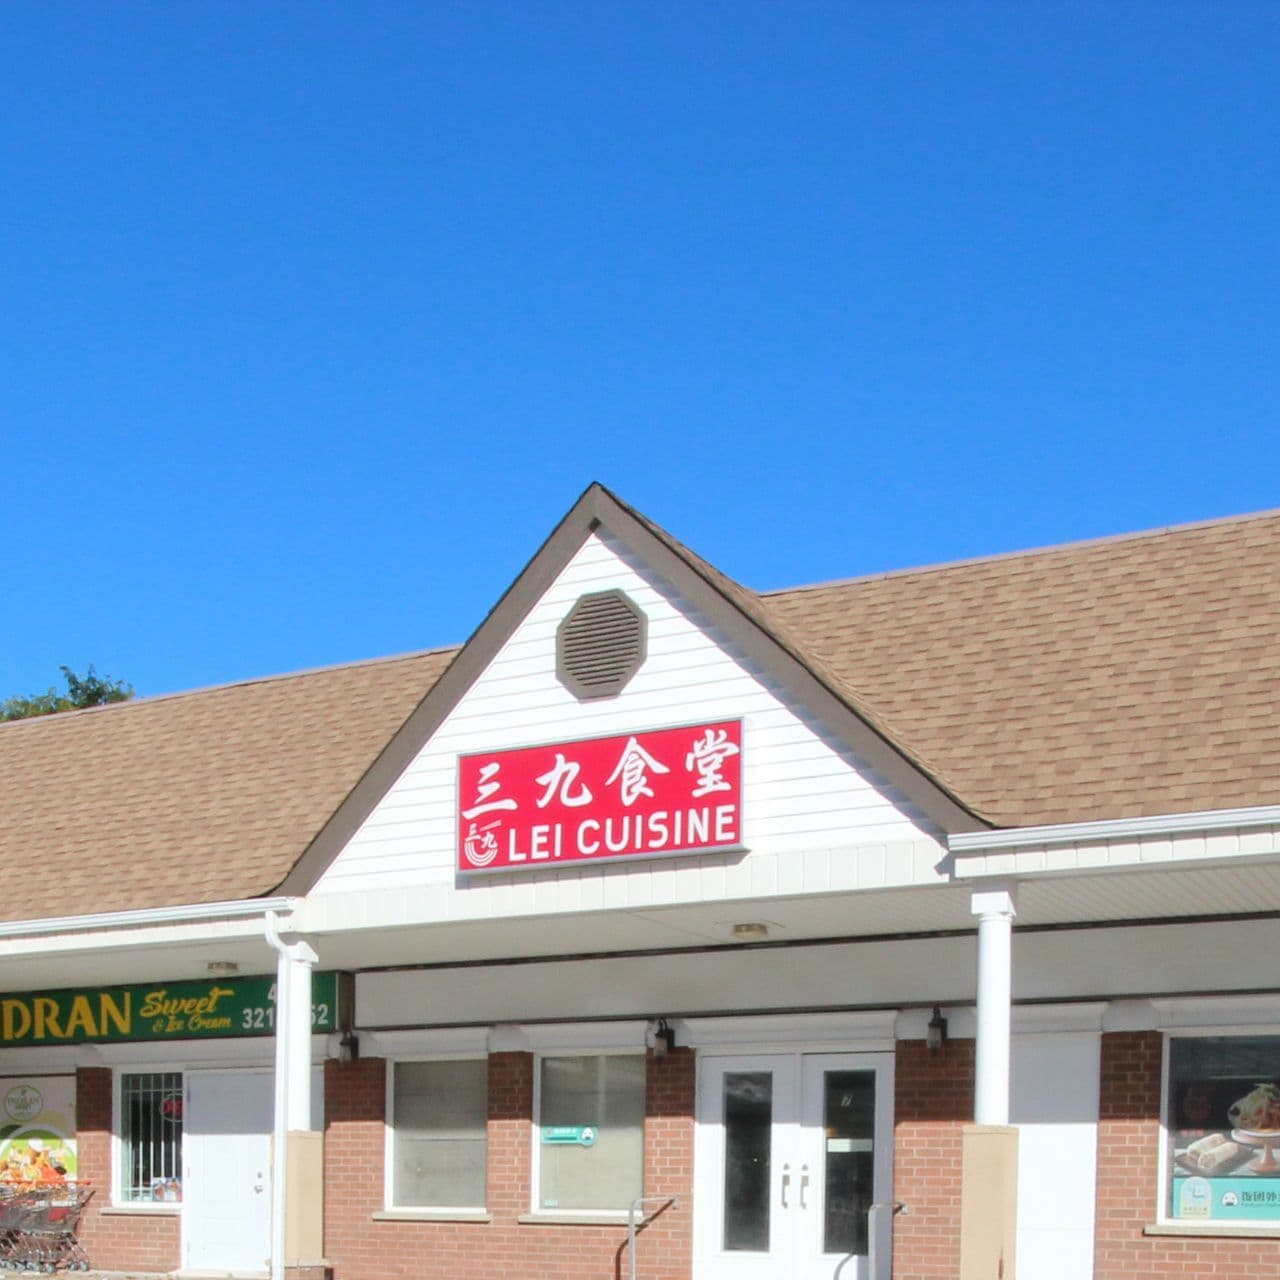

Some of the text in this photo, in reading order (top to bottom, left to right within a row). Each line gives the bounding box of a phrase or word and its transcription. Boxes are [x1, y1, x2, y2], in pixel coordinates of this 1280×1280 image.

[462, 729, 740, 819] 三九食堂
[509, 804, 736, 861] LEI CUISINE
[139, 985, 235, 1018] Sweet
[188, 1014, 232, 1031] Cream
